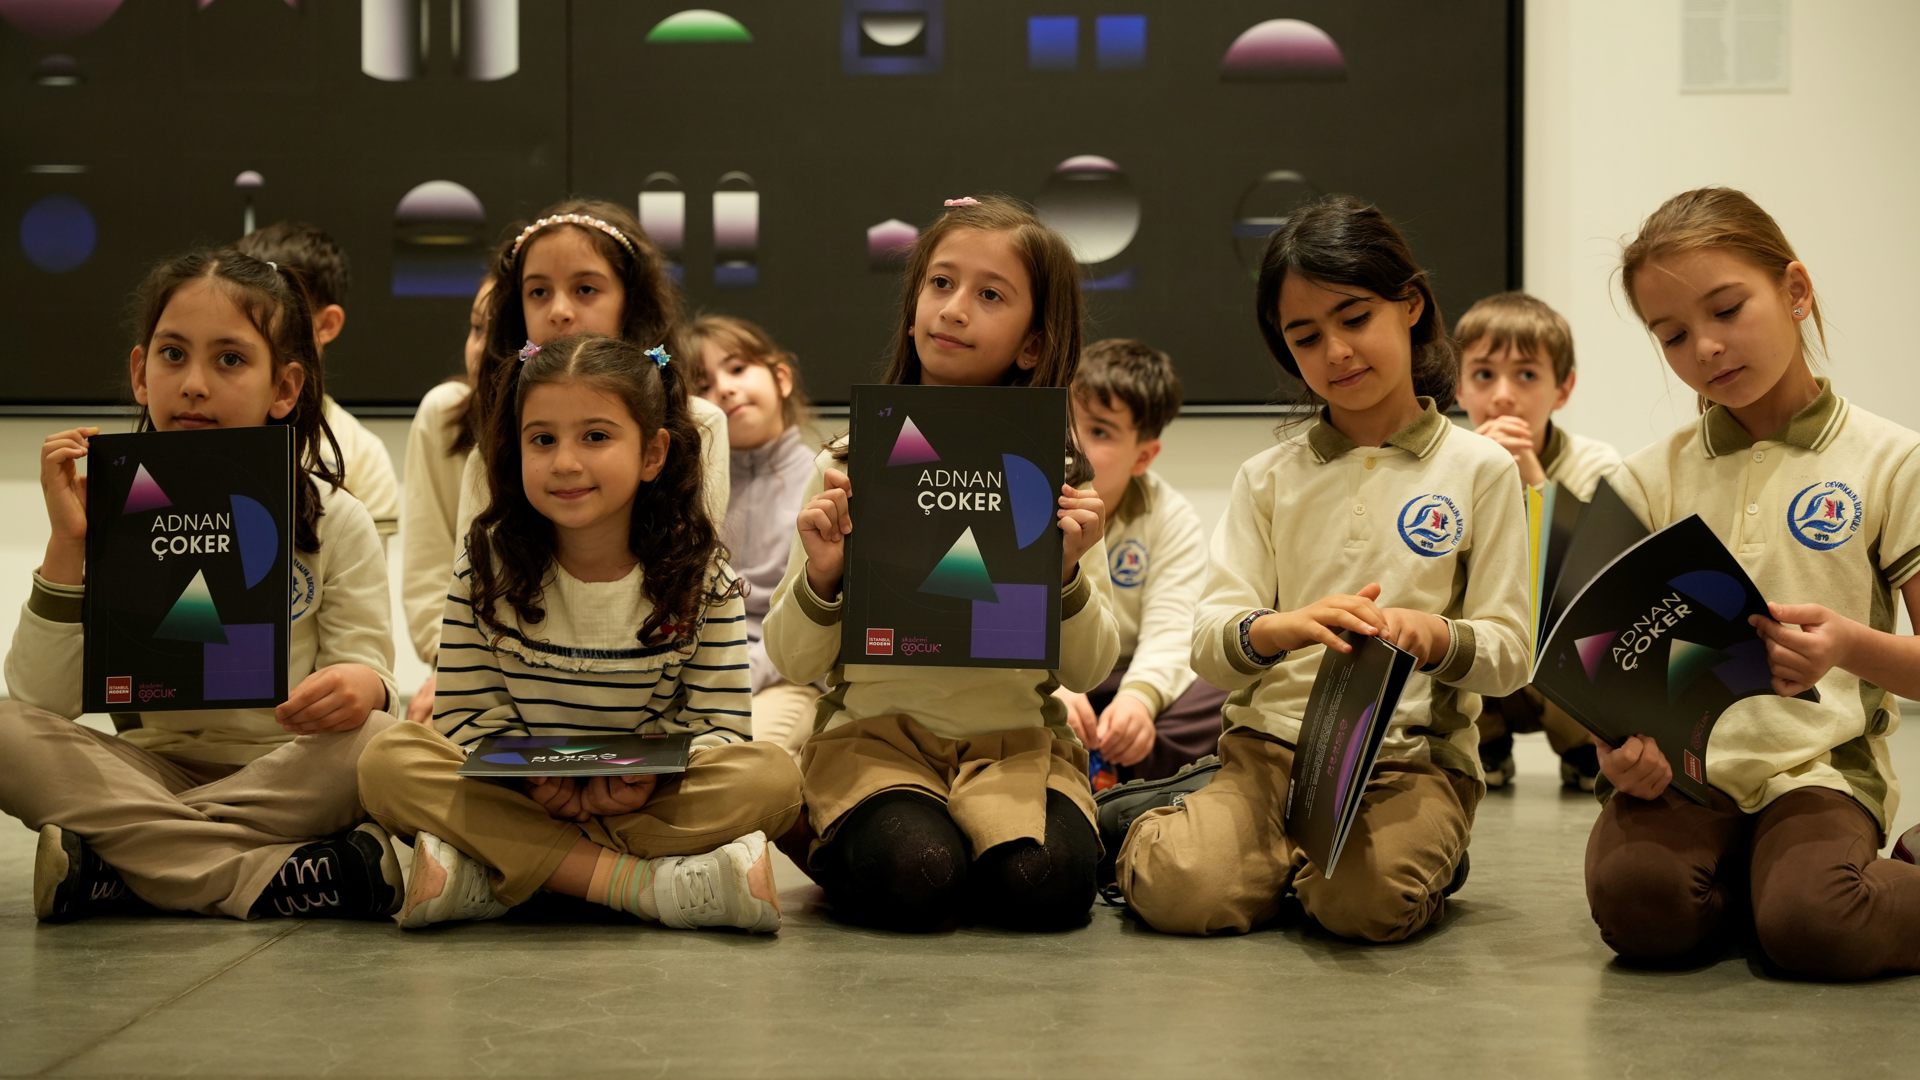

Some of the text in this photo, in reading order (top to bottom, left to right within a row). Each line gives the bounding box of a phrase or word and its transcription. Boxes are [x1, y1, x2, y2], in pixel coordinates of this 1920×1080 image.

[877, 406, 893, 417] +7
[917, 469, 1002, 489] ADNAN
[917, 490, 1002, 516] ÇOKER
[151, 513, 230, 532] ADNAN
[151, 534, 230, 561] ÇOKER
[1612, 592, 1682, 663] ADNAN
[1621, 603, 1693, 671] ÇOKER
